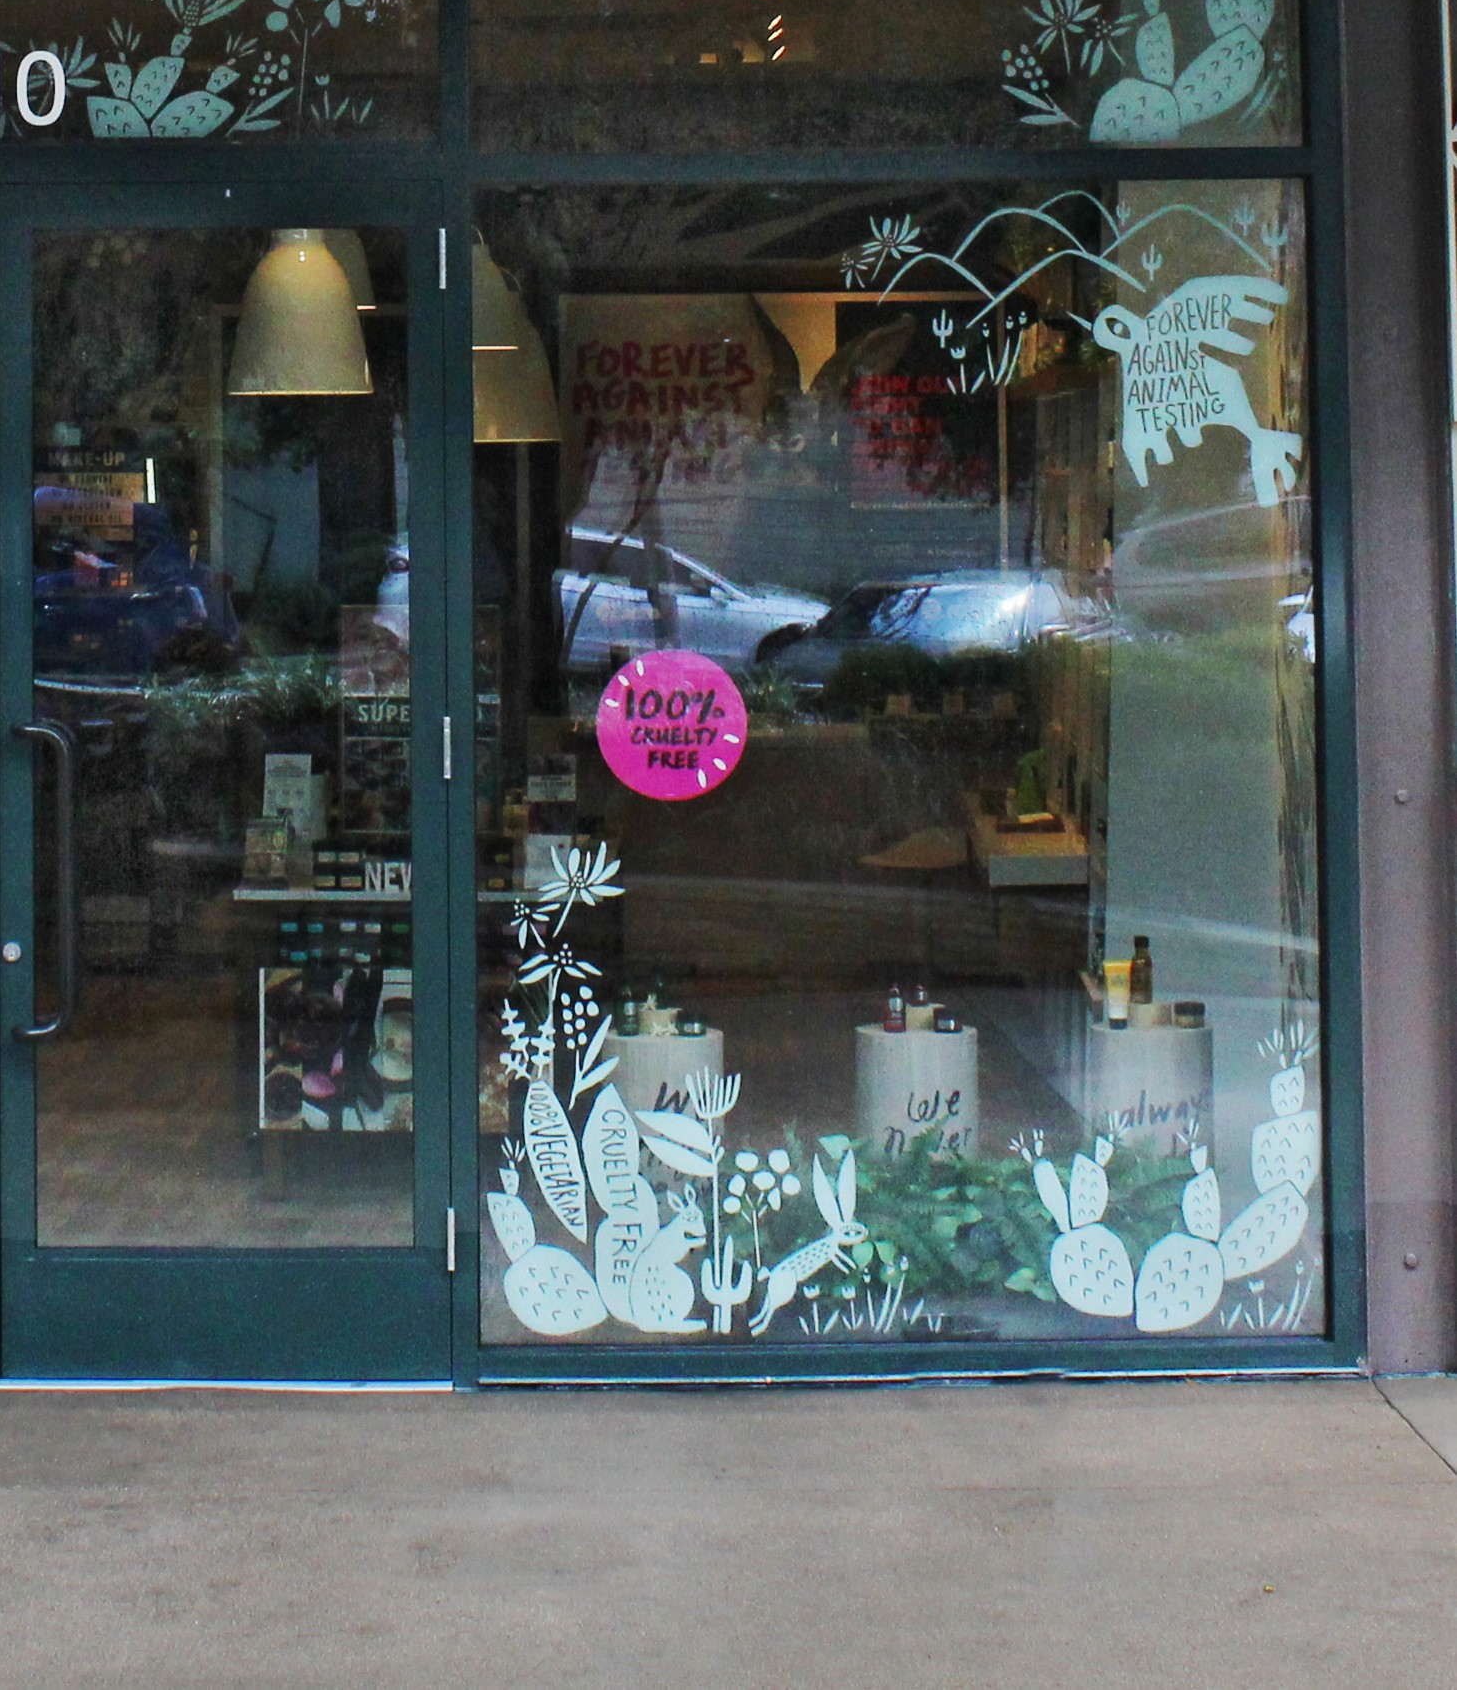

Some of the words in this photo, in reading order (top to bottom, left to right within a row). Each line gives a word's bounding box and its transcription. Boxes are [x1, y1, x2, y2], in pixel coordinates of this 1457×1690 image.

[1146, 294, 1232, 341] FOREVER
[575, 340, 757, 380] FOREVER
[1127, 336, 1207, 377] AGAINST
[573, 379, 745, 415] AGAINST
[1128, 371, 1220, 406] ANIMAL
[1135, 397, 1226, 433] TESTING
[625, 688, 726, 724] 100%
[631, 726, 718, 746] CRUELTY
[648, 750, 700, 769] FREE
[528, 1086, 558, 1126] 100%
[529, 1121, 584, 1227] VEGETARIAN
[600, 1108, 639, 1212] CRUELTY
[611, 1222, 643, 1285] FREE
